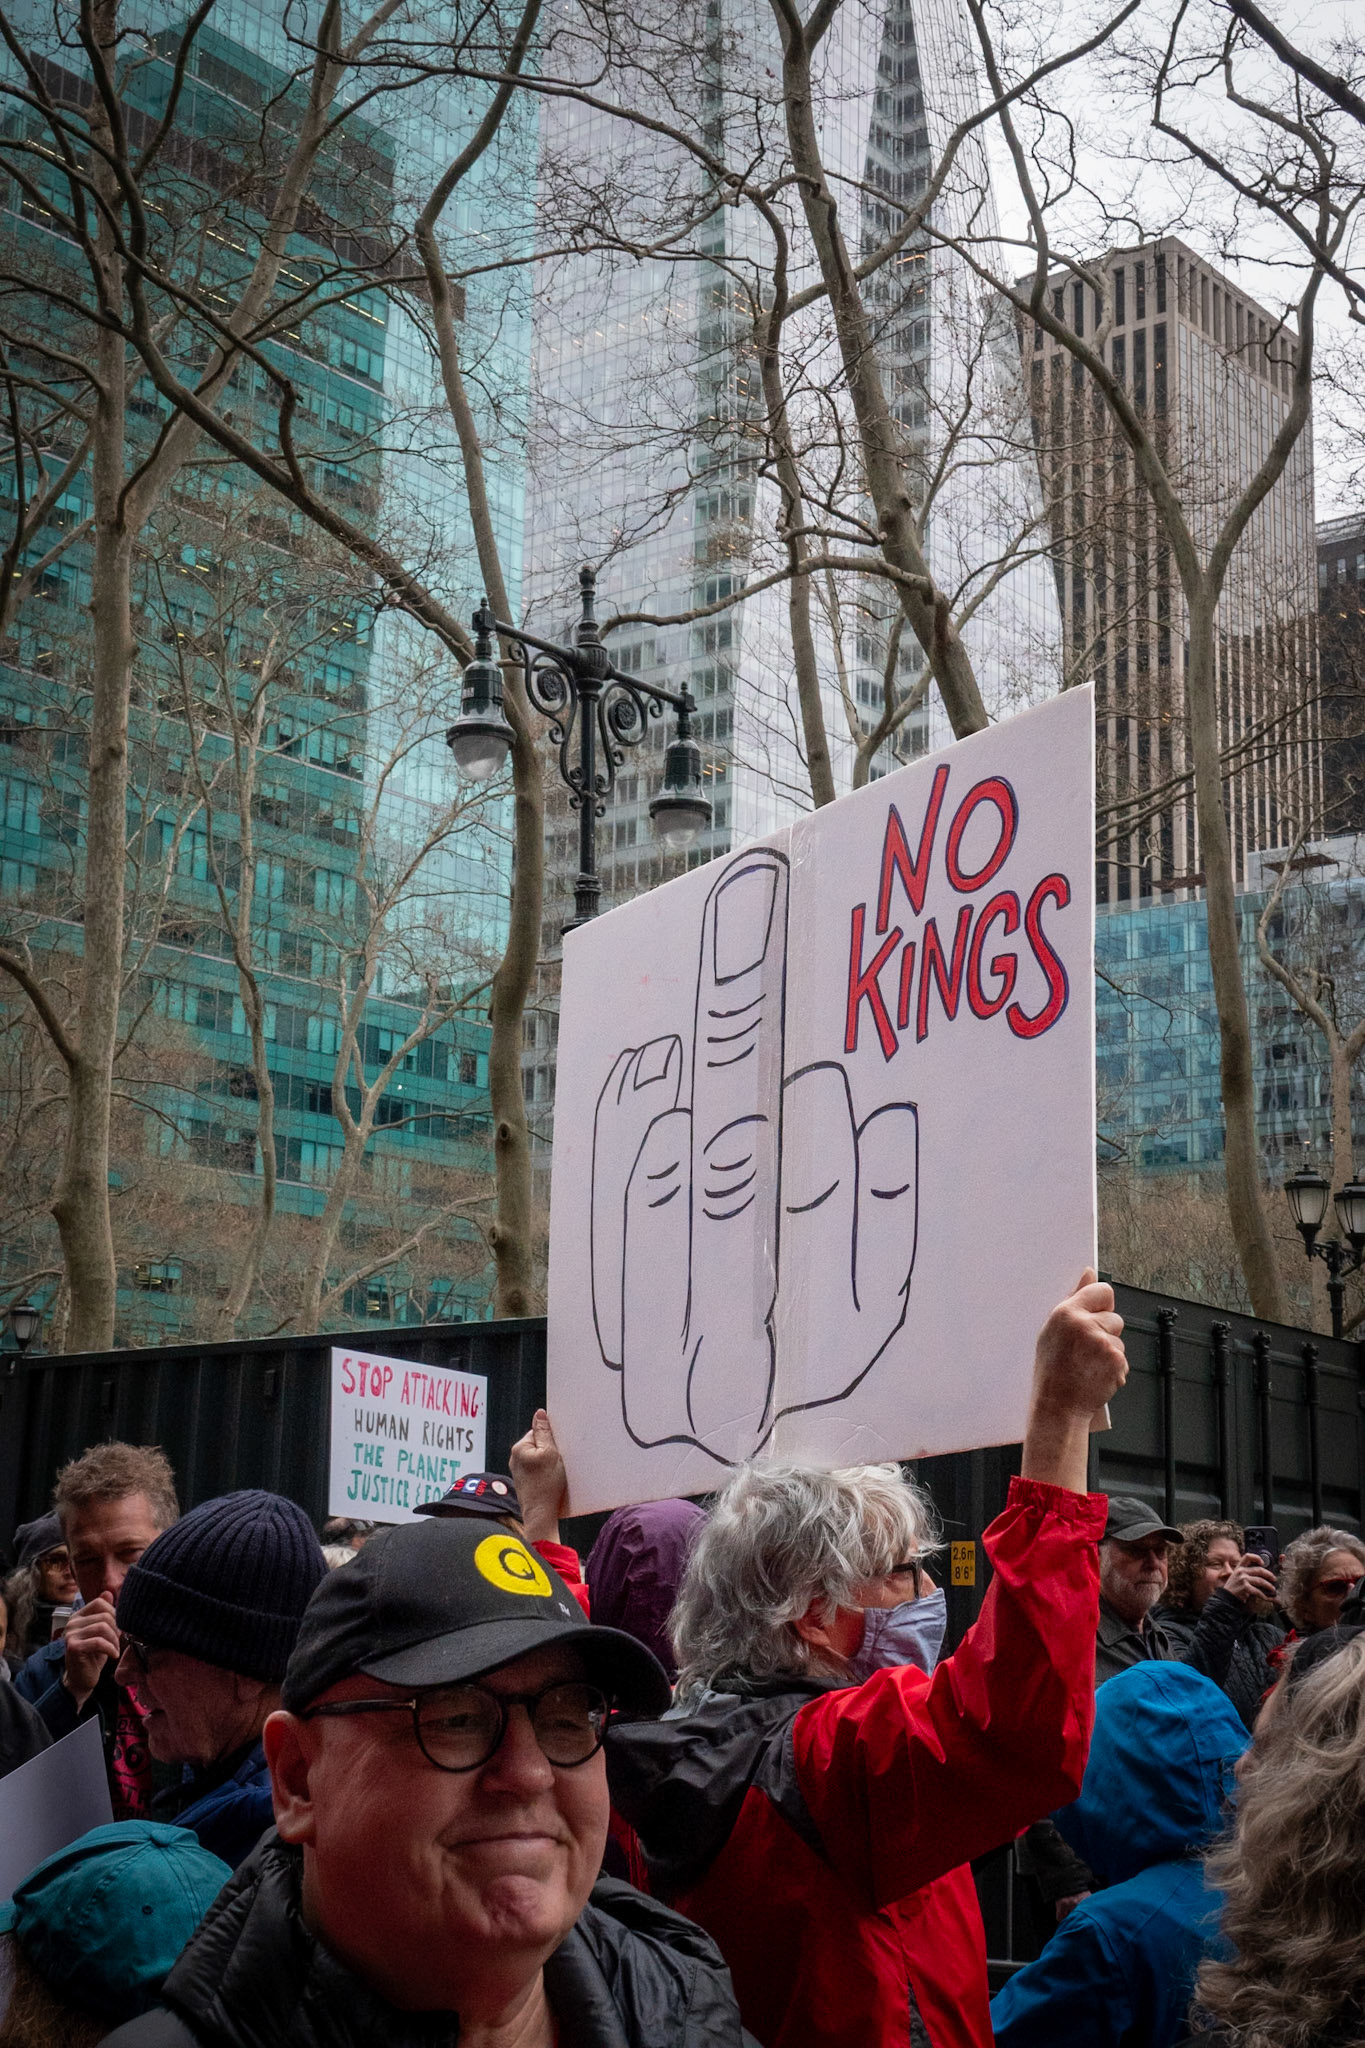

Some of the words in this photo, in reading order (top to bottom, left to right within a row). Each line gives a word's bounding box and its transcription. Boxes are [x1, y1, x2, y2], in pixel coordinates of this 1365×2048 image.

[876, 764, 1019, 935] NO
[844, 873, 1071, 1063] KINGS
[341, 1358, 393, 1399] STOP
[400, 1371, 484, 1418] ATTACKING:
[354, 1408, 410, 1441] HUMAN
[422, 1420, 474, 1453] RIGHTS
[347, 1469, 410, 1508] JUSTICE
[353, 1442, 385, 1468] THE
[397, 1449, 461, 1483] PLANET
